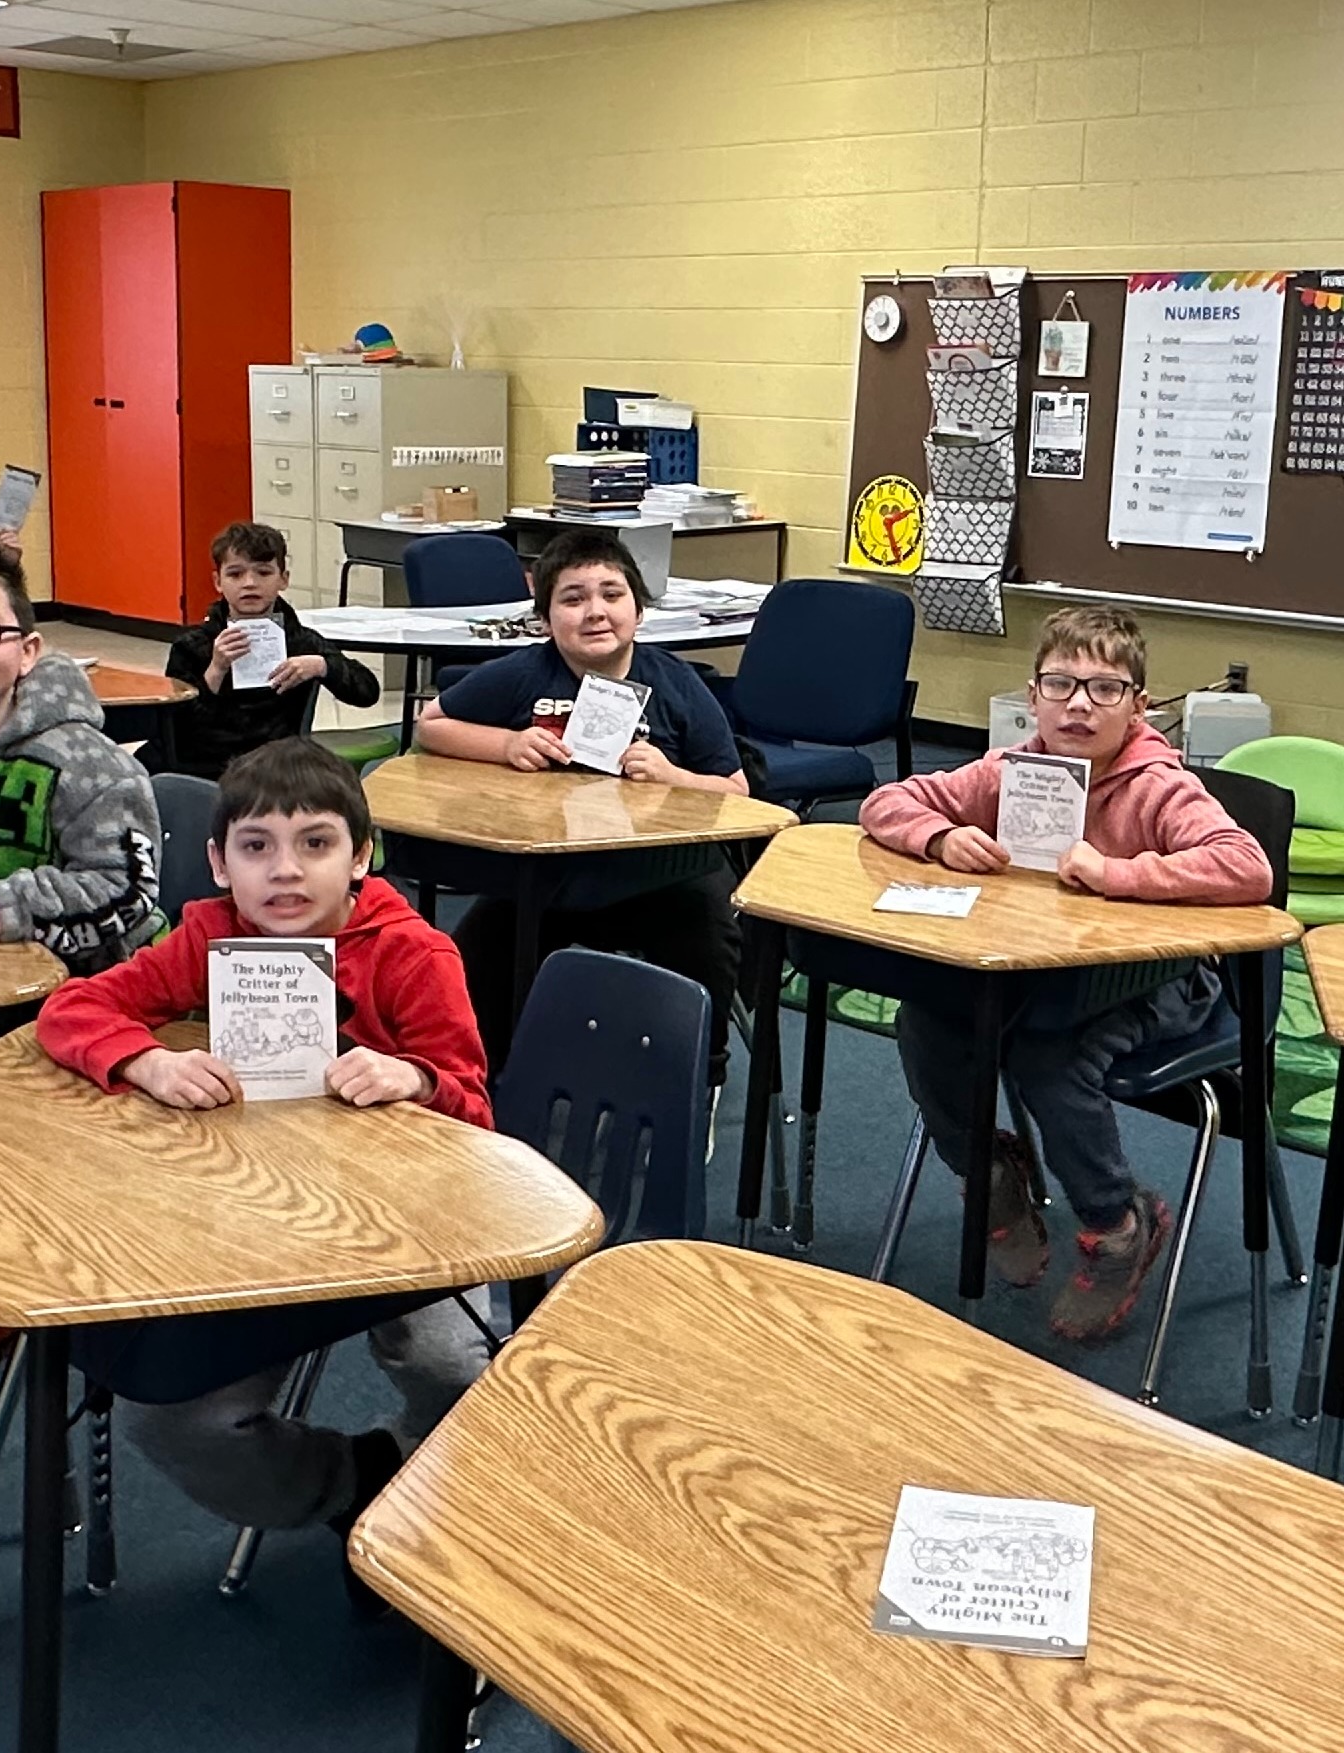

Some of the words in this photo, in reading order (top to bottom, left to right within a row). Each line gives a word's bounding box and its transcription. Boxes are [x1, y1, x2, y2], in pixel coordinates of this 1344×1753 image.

[1164, 306, 1241, 321] NUMBERS
[1143, 353, 1150, 363] 2
[1142, 372, 1149, 382] 3
[1139, 409, 1145, 419] 5
[1138, 428, 1144, 437] 6
[1136, 445, 1143, 455] 7
[888, 484, 897, 496] 12
[1133, 482, 1139, 491] 9
[877, 486, 883, 499] 11
[1127, 500, 1138, 510] 10
[859, 515, 865, 525] 9
[912, 519, 920, 530] 3
[870, 544, 877, 554] 7
[881, 549, 888, 561] 6
[231, 962, 254, 975] The
[259, 963, 305, 978] Mighty
[238, 978, 280, 989] Critter
[286, 978, 298, 989] of
[220, 991, 280, 1005] Jellybean
[284, 992, 319, 1003] Town
[912, 1576, 966, 1592] Town
[974, 1582, 1072, 1602] Jellybean
[939, 1593, 961, 1604] of
[971, 1595, 1040, 1611] Critter
[927, 1603, 1003, 1623] Mighty
[1011, 1612, 1048, 1627] The
